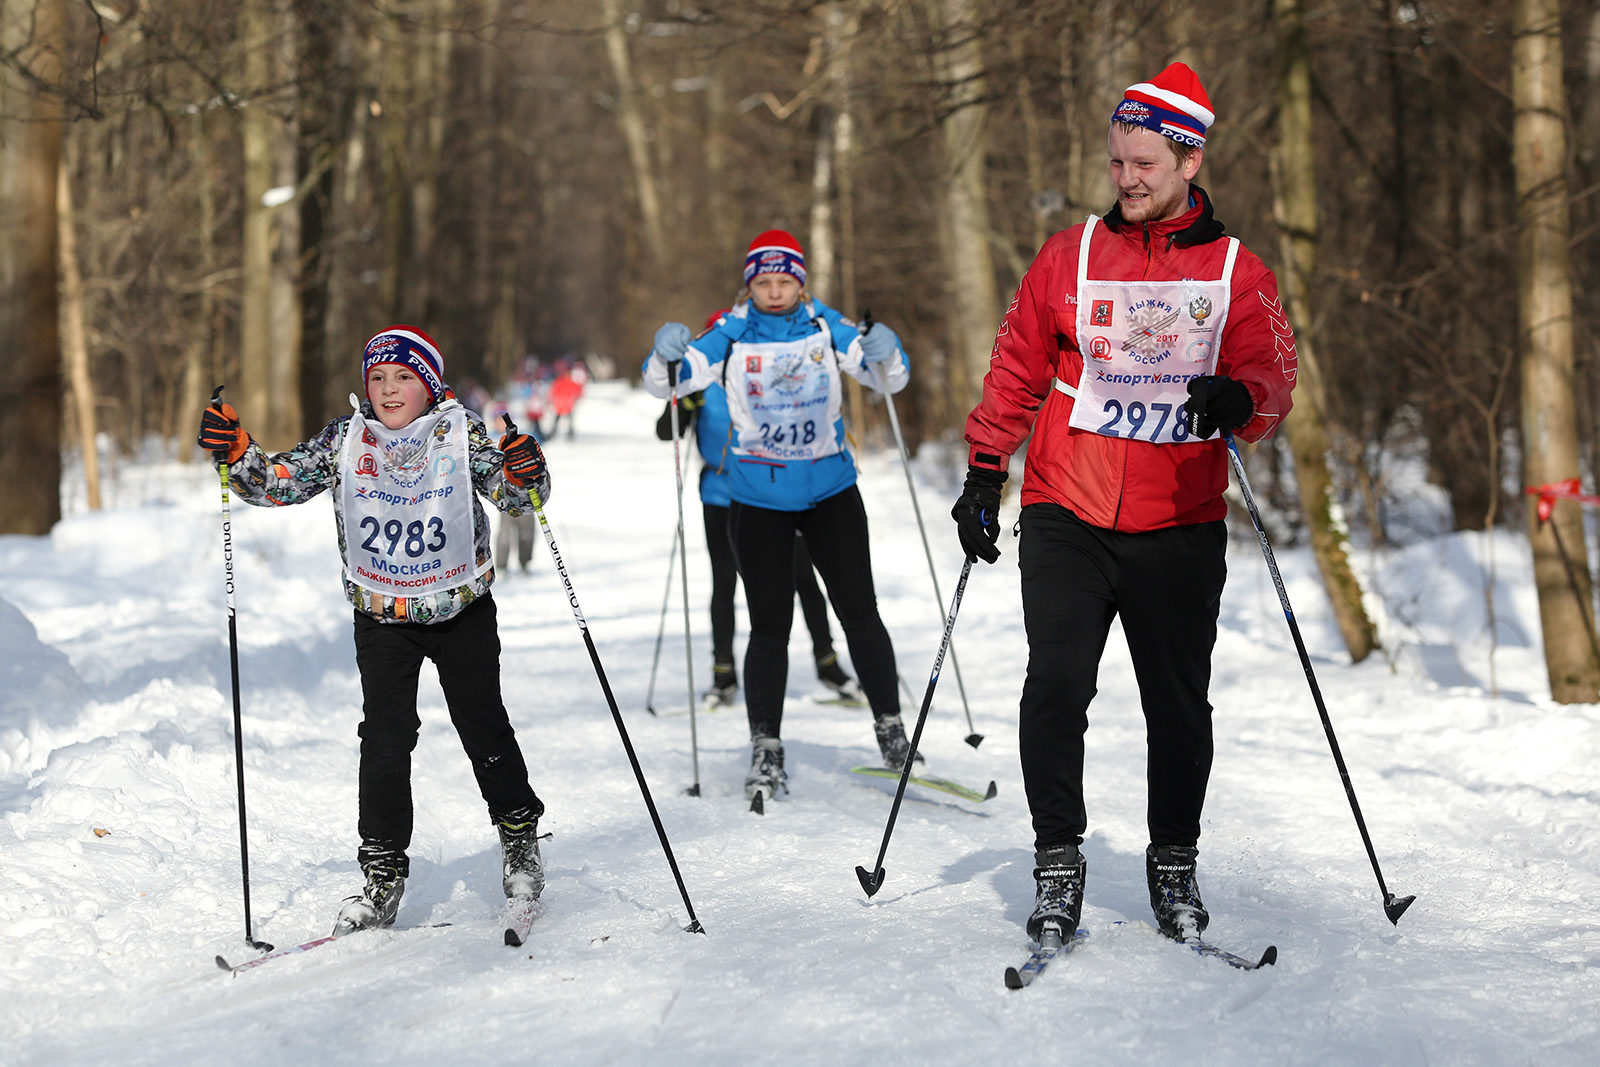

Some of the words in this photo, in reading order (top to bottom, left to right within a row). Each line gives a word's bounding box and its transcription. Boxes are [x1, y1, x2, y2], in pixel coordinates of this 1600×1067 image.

[1128, 299, 1173, 315] ЛЫЖНЯ
[1156, 334, 1180, 342] 2017
[366, 353, 398, 369] 2017
[1128, 350, 1172, 365] РОССИИ
[1097, 399, 1189, 443] 2978
[385, 437, 422, 452] ЛЫЖНЯ
[389, 473, 425, 488] РОССИИ
[360, 516, 446, 558] 2983
[371, 556, 442, 575] Москва
[357, 566, 392, 585] ЛЫЖНЯ
[394, 575, 437, 588] РОССИИ
[445, 564, 467, 579] 2017
